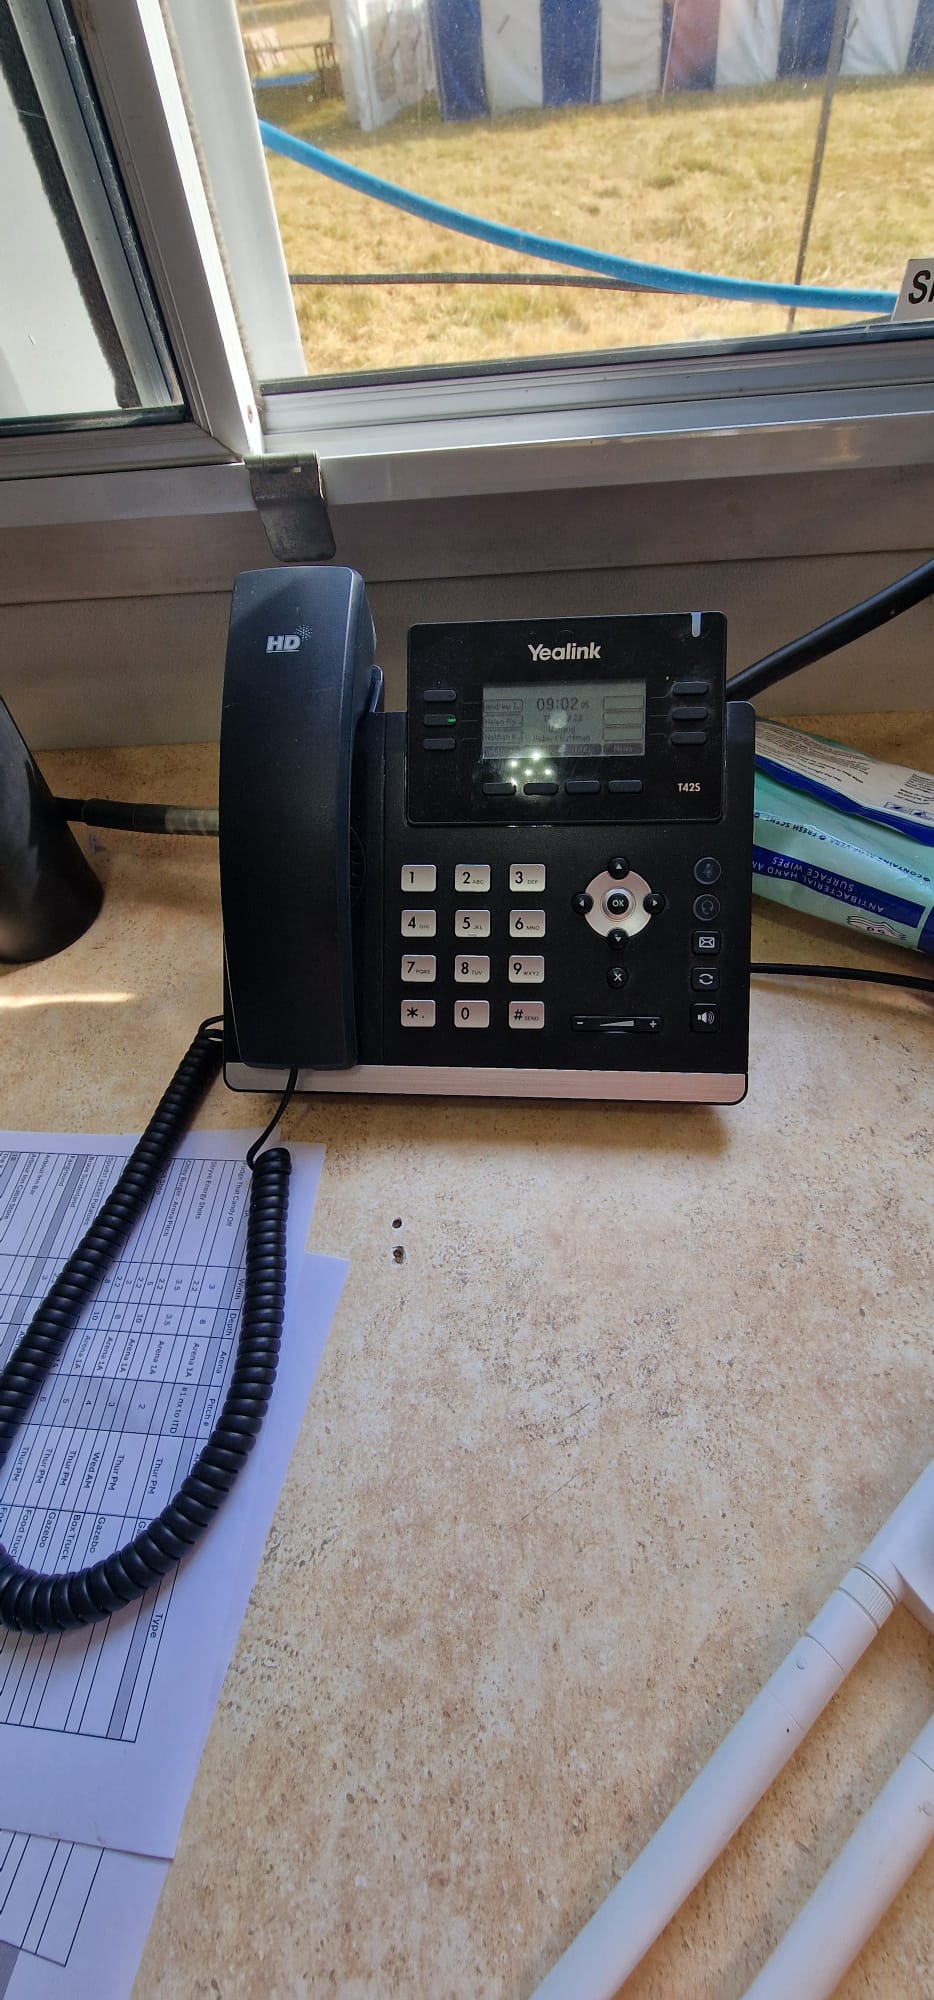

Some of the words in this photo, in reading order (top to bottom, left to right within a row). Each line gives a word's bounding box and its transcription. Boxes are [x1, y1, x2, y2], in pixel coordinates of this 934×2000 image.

[266, 634, 301, 653] HD
[528, 642, 601, 661] Yealink
[536, 696, 578, 711] 09:02
[677, 782, 701, 792] T42S
[793, 824, 817, 838] FRESH
[752, 861, 765, 871] AN
[772, 856, 804, 873] WIPES
[409, 871, 415, 884] 1
[462, 871, 471, 884] 2
[515, 871, 523, 884] 3
[767, 867, 798, 880] HAND
[807, 868, 854, 892] SURFACE
[801, 875, 885, 913] ANTIBACTERIAL
[612, 899, 625, 907] OK
[407, 916, 417, 929] 4
[462, 917, 471, 930] 5
[515, 917, 524, 930] 6
[407, 961, 416, 974] 7
[461, 961, 470, 975] 8
[513, 962, 522, 976] 9
[460, 1007, 470, 1020] 0
[513, 1008, 524, 1021] #
[168, 1202, 179, 1220] Arena
[163, 1221, 174, 1237] Pitch
[234, 1278, 246, 1300] Width
[225, 1313, 237, 1336] Depth
[101, 1337, 113, 1359] Arena
[124, 1338, 136, 1361] Arena
[153, 1341, 165, 1363] Arena
[188, 1343, 200, 1365] Arena
[96, 1360, 105, 1371] 1A
[120, 1362, 128, 1373] 1A
[149, 1365, 158, 1375] 1A
[216, 1351, 228, 1374] Arena
[185, 1366, 194, 1378] 1A
[204, 1398, 216, 1420] Pitch
[18, 1447, 30, 1466] Thur
[41, 1447, 53, 1468] Thur
[65, 1450, 77, 1470] Thur
[88, 1452, 101, 1473] Wed
[113, 1455, 125, 1475] Thur
[152, 1459, 163, 1478] Thur
[12, 1467, 22, 1482] PM
[35, 1469, 46, 1484] PM
[60, 1471, 70, 1486] PM
[84, 1475, 93, 1489] AM
[107, 1476, 119, 1491] PM
[148, 1479, 158, 1494] PM
[20, 1509, 33, 1533] Food
[70, 1514, 82, 1532] Box
[39, 1511, 56, 1549] Gazebo
[89, 1516, 106, 1554] Gazebo
[60, 1533, 75, 1561] Truck
[150, 1613, 163, 1639] Type
